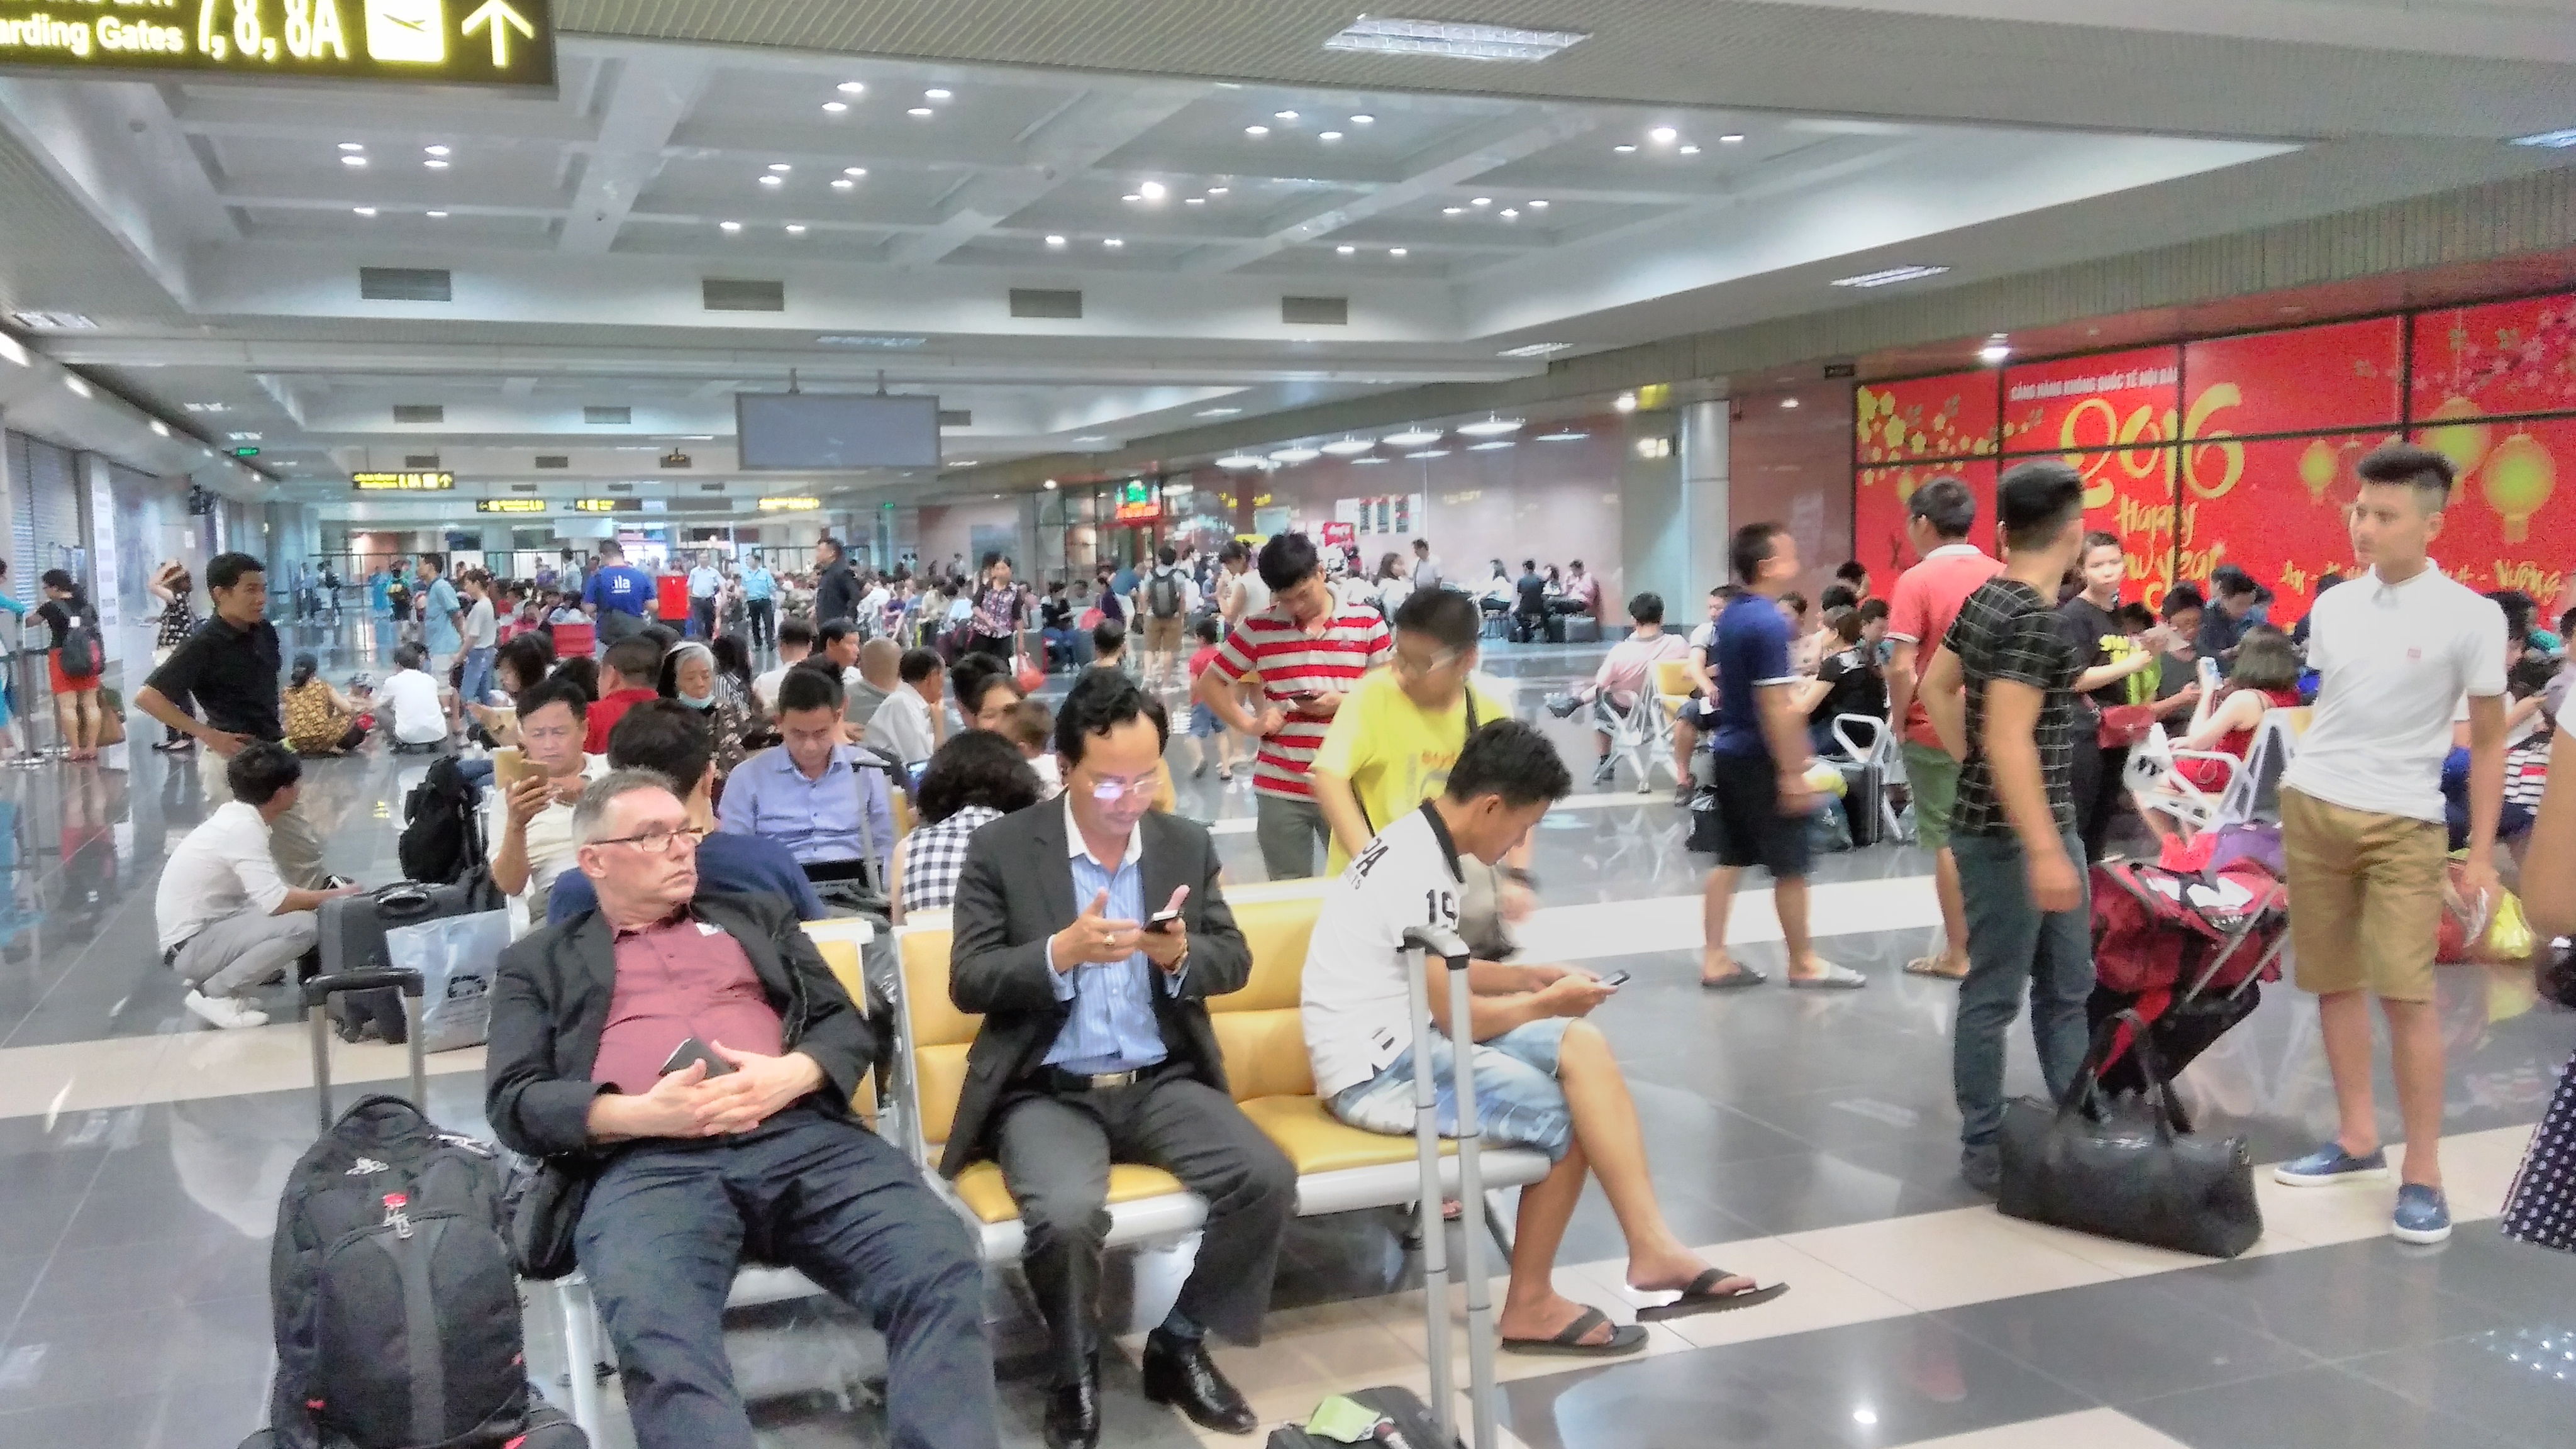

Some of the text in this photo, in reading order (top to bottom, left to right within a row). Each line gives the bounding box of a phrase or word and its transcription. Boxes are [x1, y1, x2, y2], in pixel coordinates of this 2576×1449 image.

[96, 16, 184, 51] Gates
[284, 0, 348, 58] 8A
[2061, 383, 2245, 508] 2016
[2114, 493, 2199, 548] Happy
